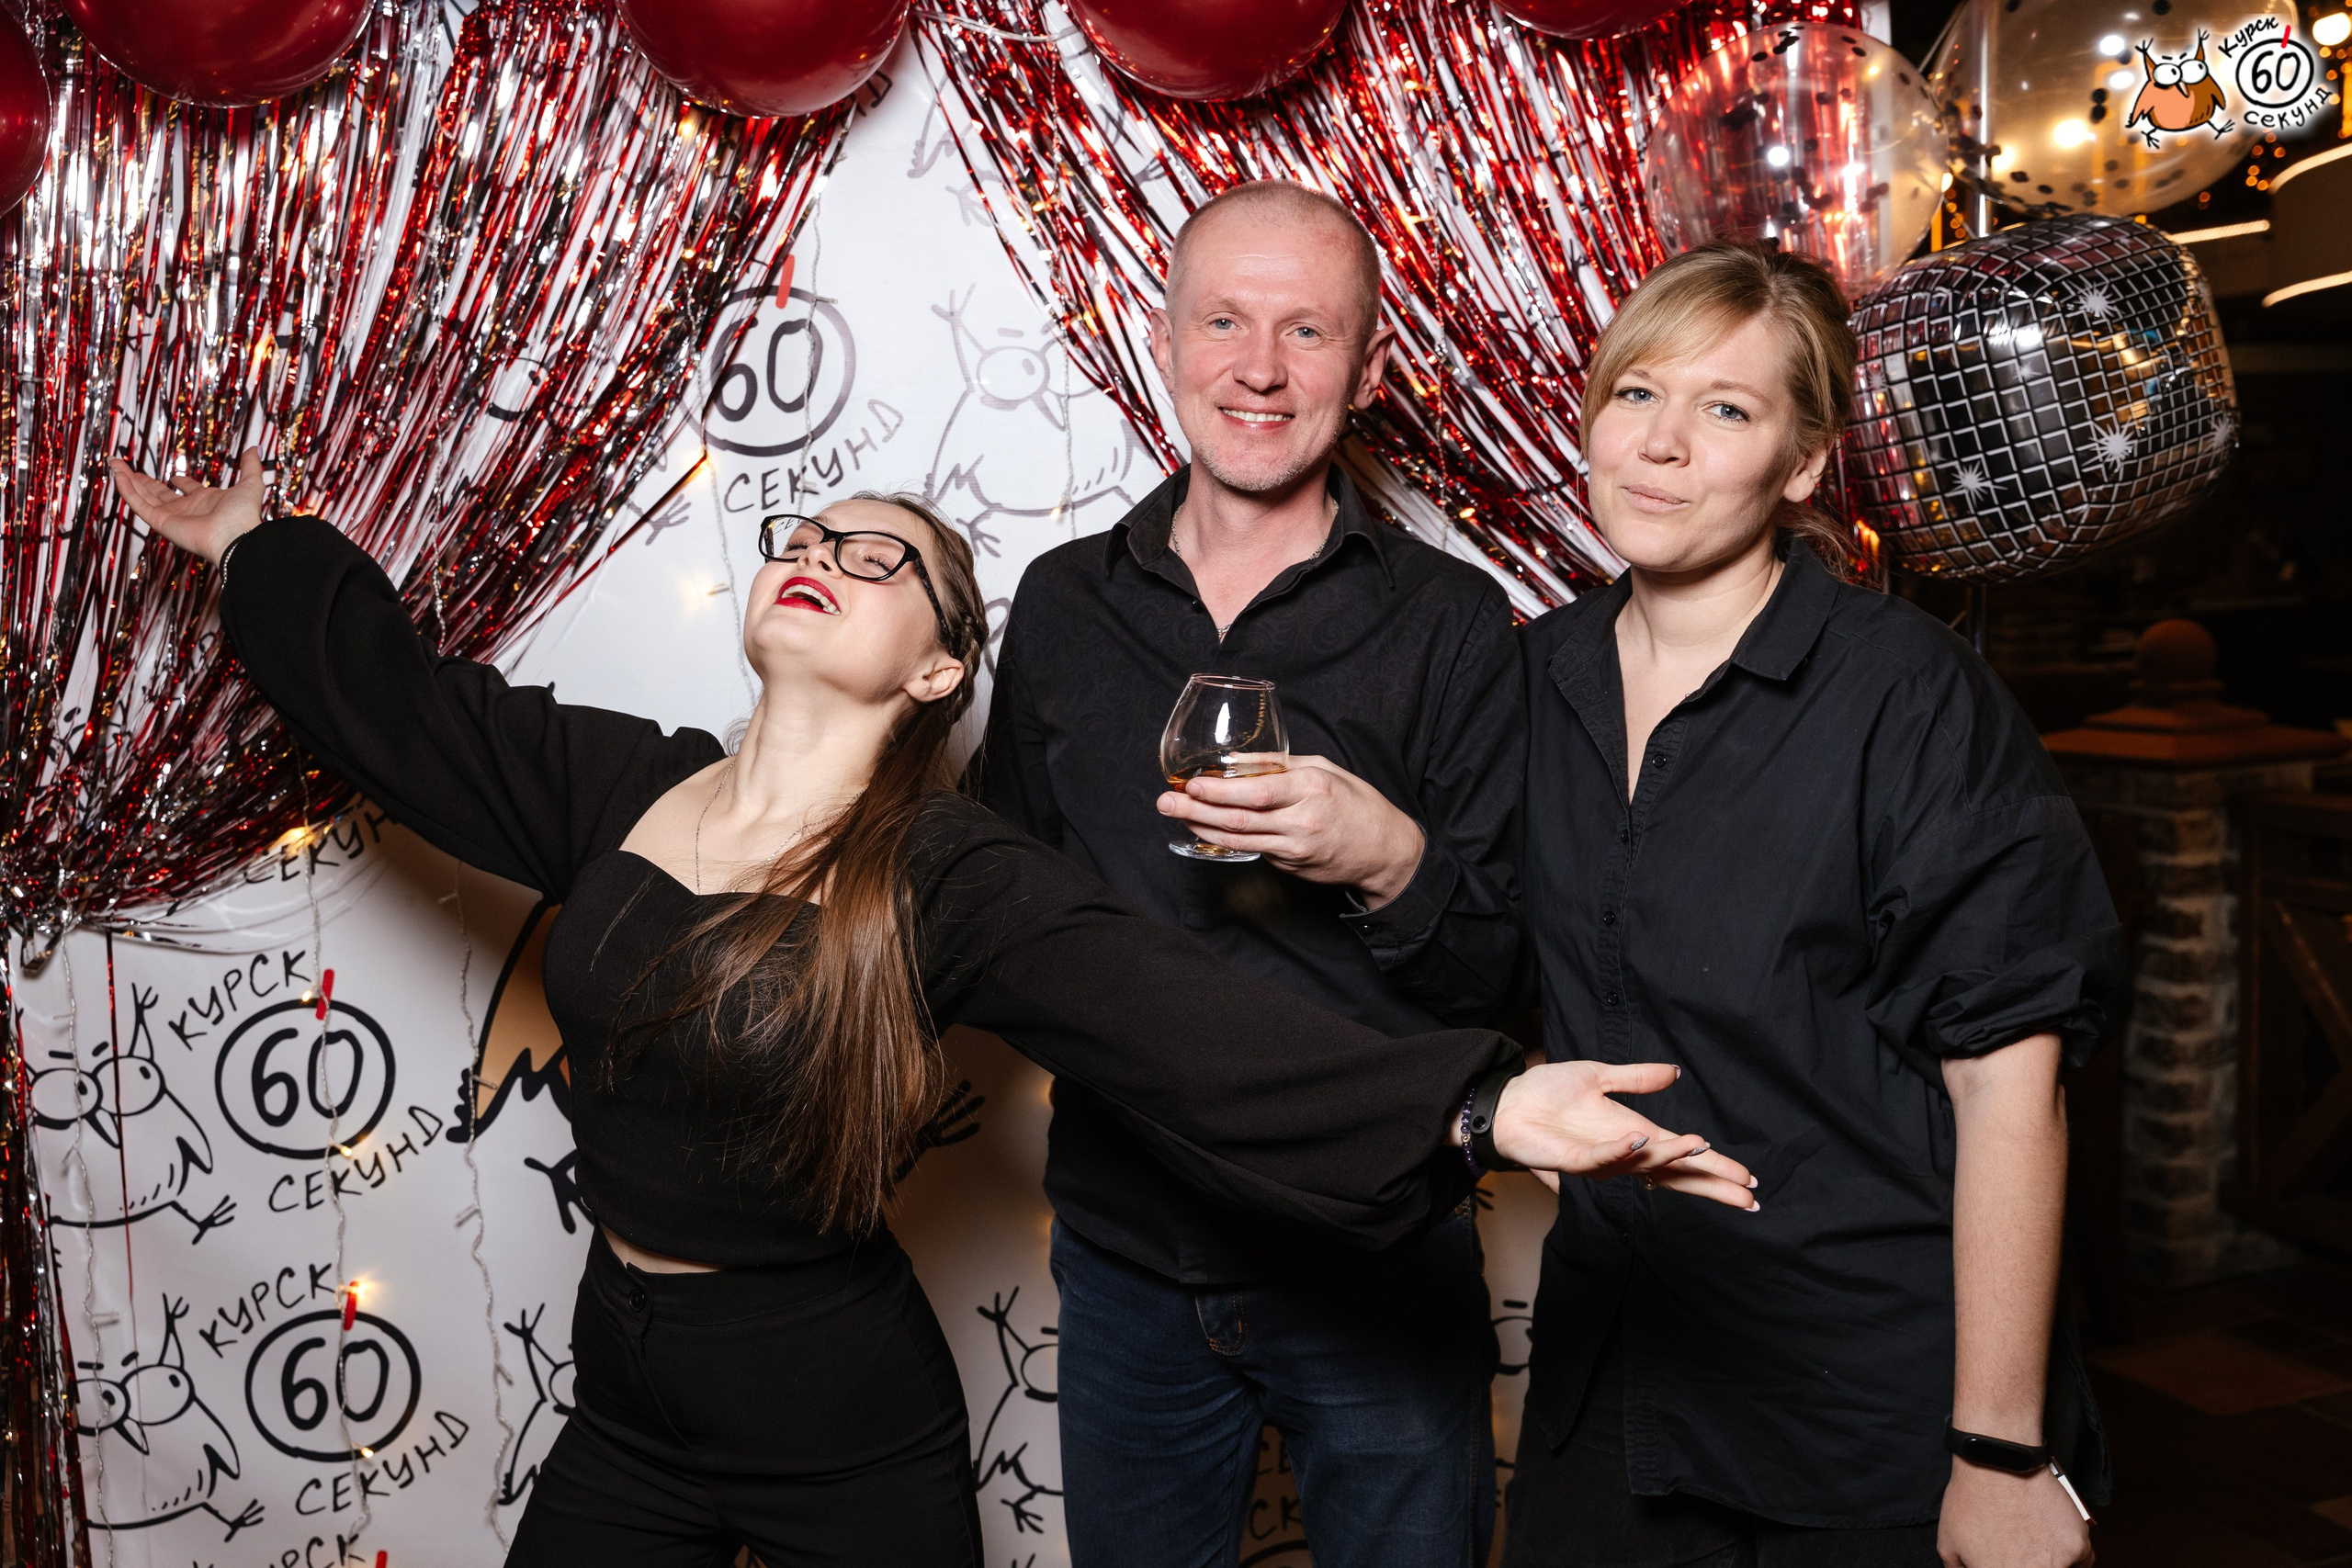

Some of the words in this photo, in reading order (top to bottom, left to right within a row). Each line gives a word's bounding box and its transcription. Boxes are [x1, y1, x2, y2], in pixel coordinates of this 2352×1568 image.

[710, 317, 823, 422] 60
[724, 399, 904, 513] СЕКУНД
[169, 951, 311, 1050] КУРСК
[251, 1028, 364, 1126] 60
[269, 1106, 444, 1213] СЕКУНД
[199, 1263, 335, 1358] КУРСК
[281, 1337, 390, 1430] 60
[296, 1411, 469, 1515] СЕКУНД
